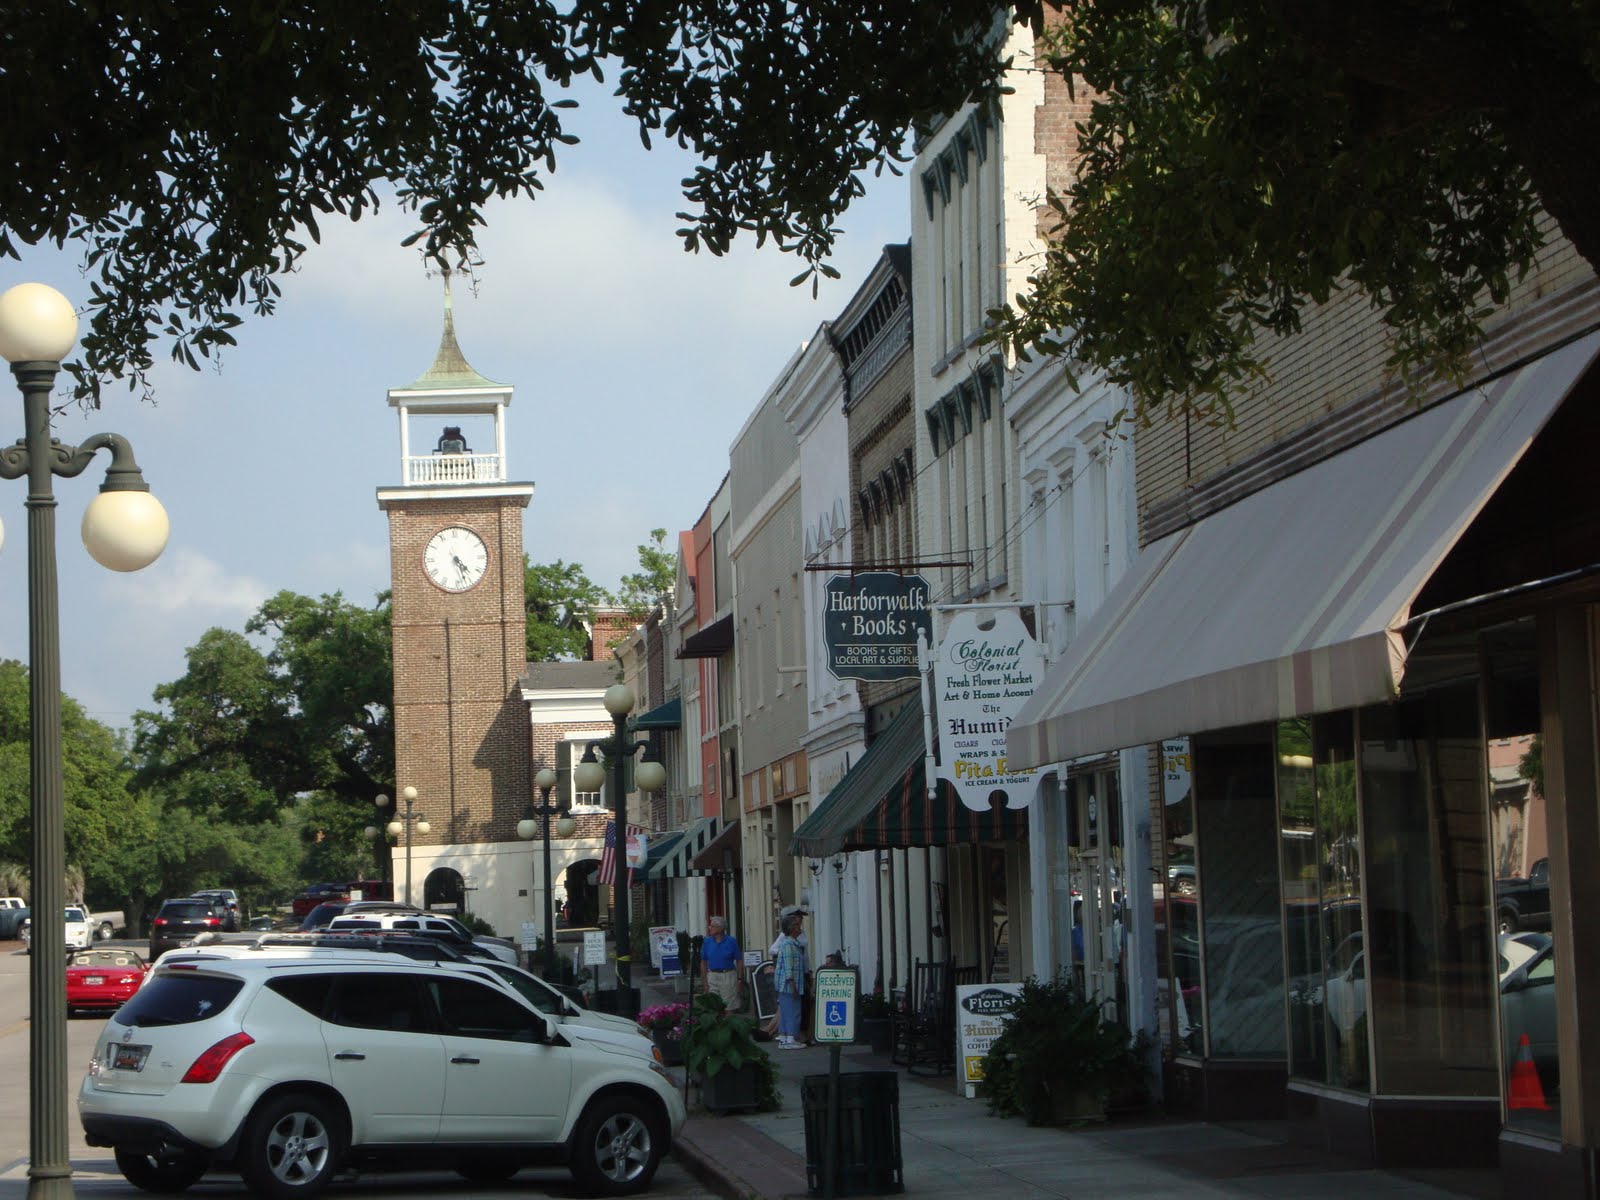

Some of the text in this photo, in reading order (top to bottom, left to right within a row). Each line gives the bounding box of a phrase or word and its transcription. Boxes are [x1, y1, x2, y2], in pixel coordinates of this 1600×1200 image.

[830, 587, 926, 612] Harborwalk
[852, 611, 907, 636] Books
[847, 647, 912, 655] BOOKS GIFTS
[951, 639, 1024, 664] Colonial
[835, 655, 919, 664] LOCAL ART & SUPPLIE
[964, 658, 1020, 673] Florist
[947, 672, 1033, 688] Fresh Flower Market
[944, 690, 959, 702] Art
[963, 691, 970, 700] &
[973, 689, 1000, 700] Home
[982, 704, 1000, 715] The
[954, 740, 978, 748] CIGARS
[959, 750, 989, 758] WRAPS
[954, 759, 994, 780] Pita
[1005, 776, 1030, 784] YOGURT
[820, 977, 854, 986] RESERVED
[822, 989, 851, 998] PARKING
[969, 998, 1016, 1010] Florist
[826, 1029, 845, 1037] ONLY
